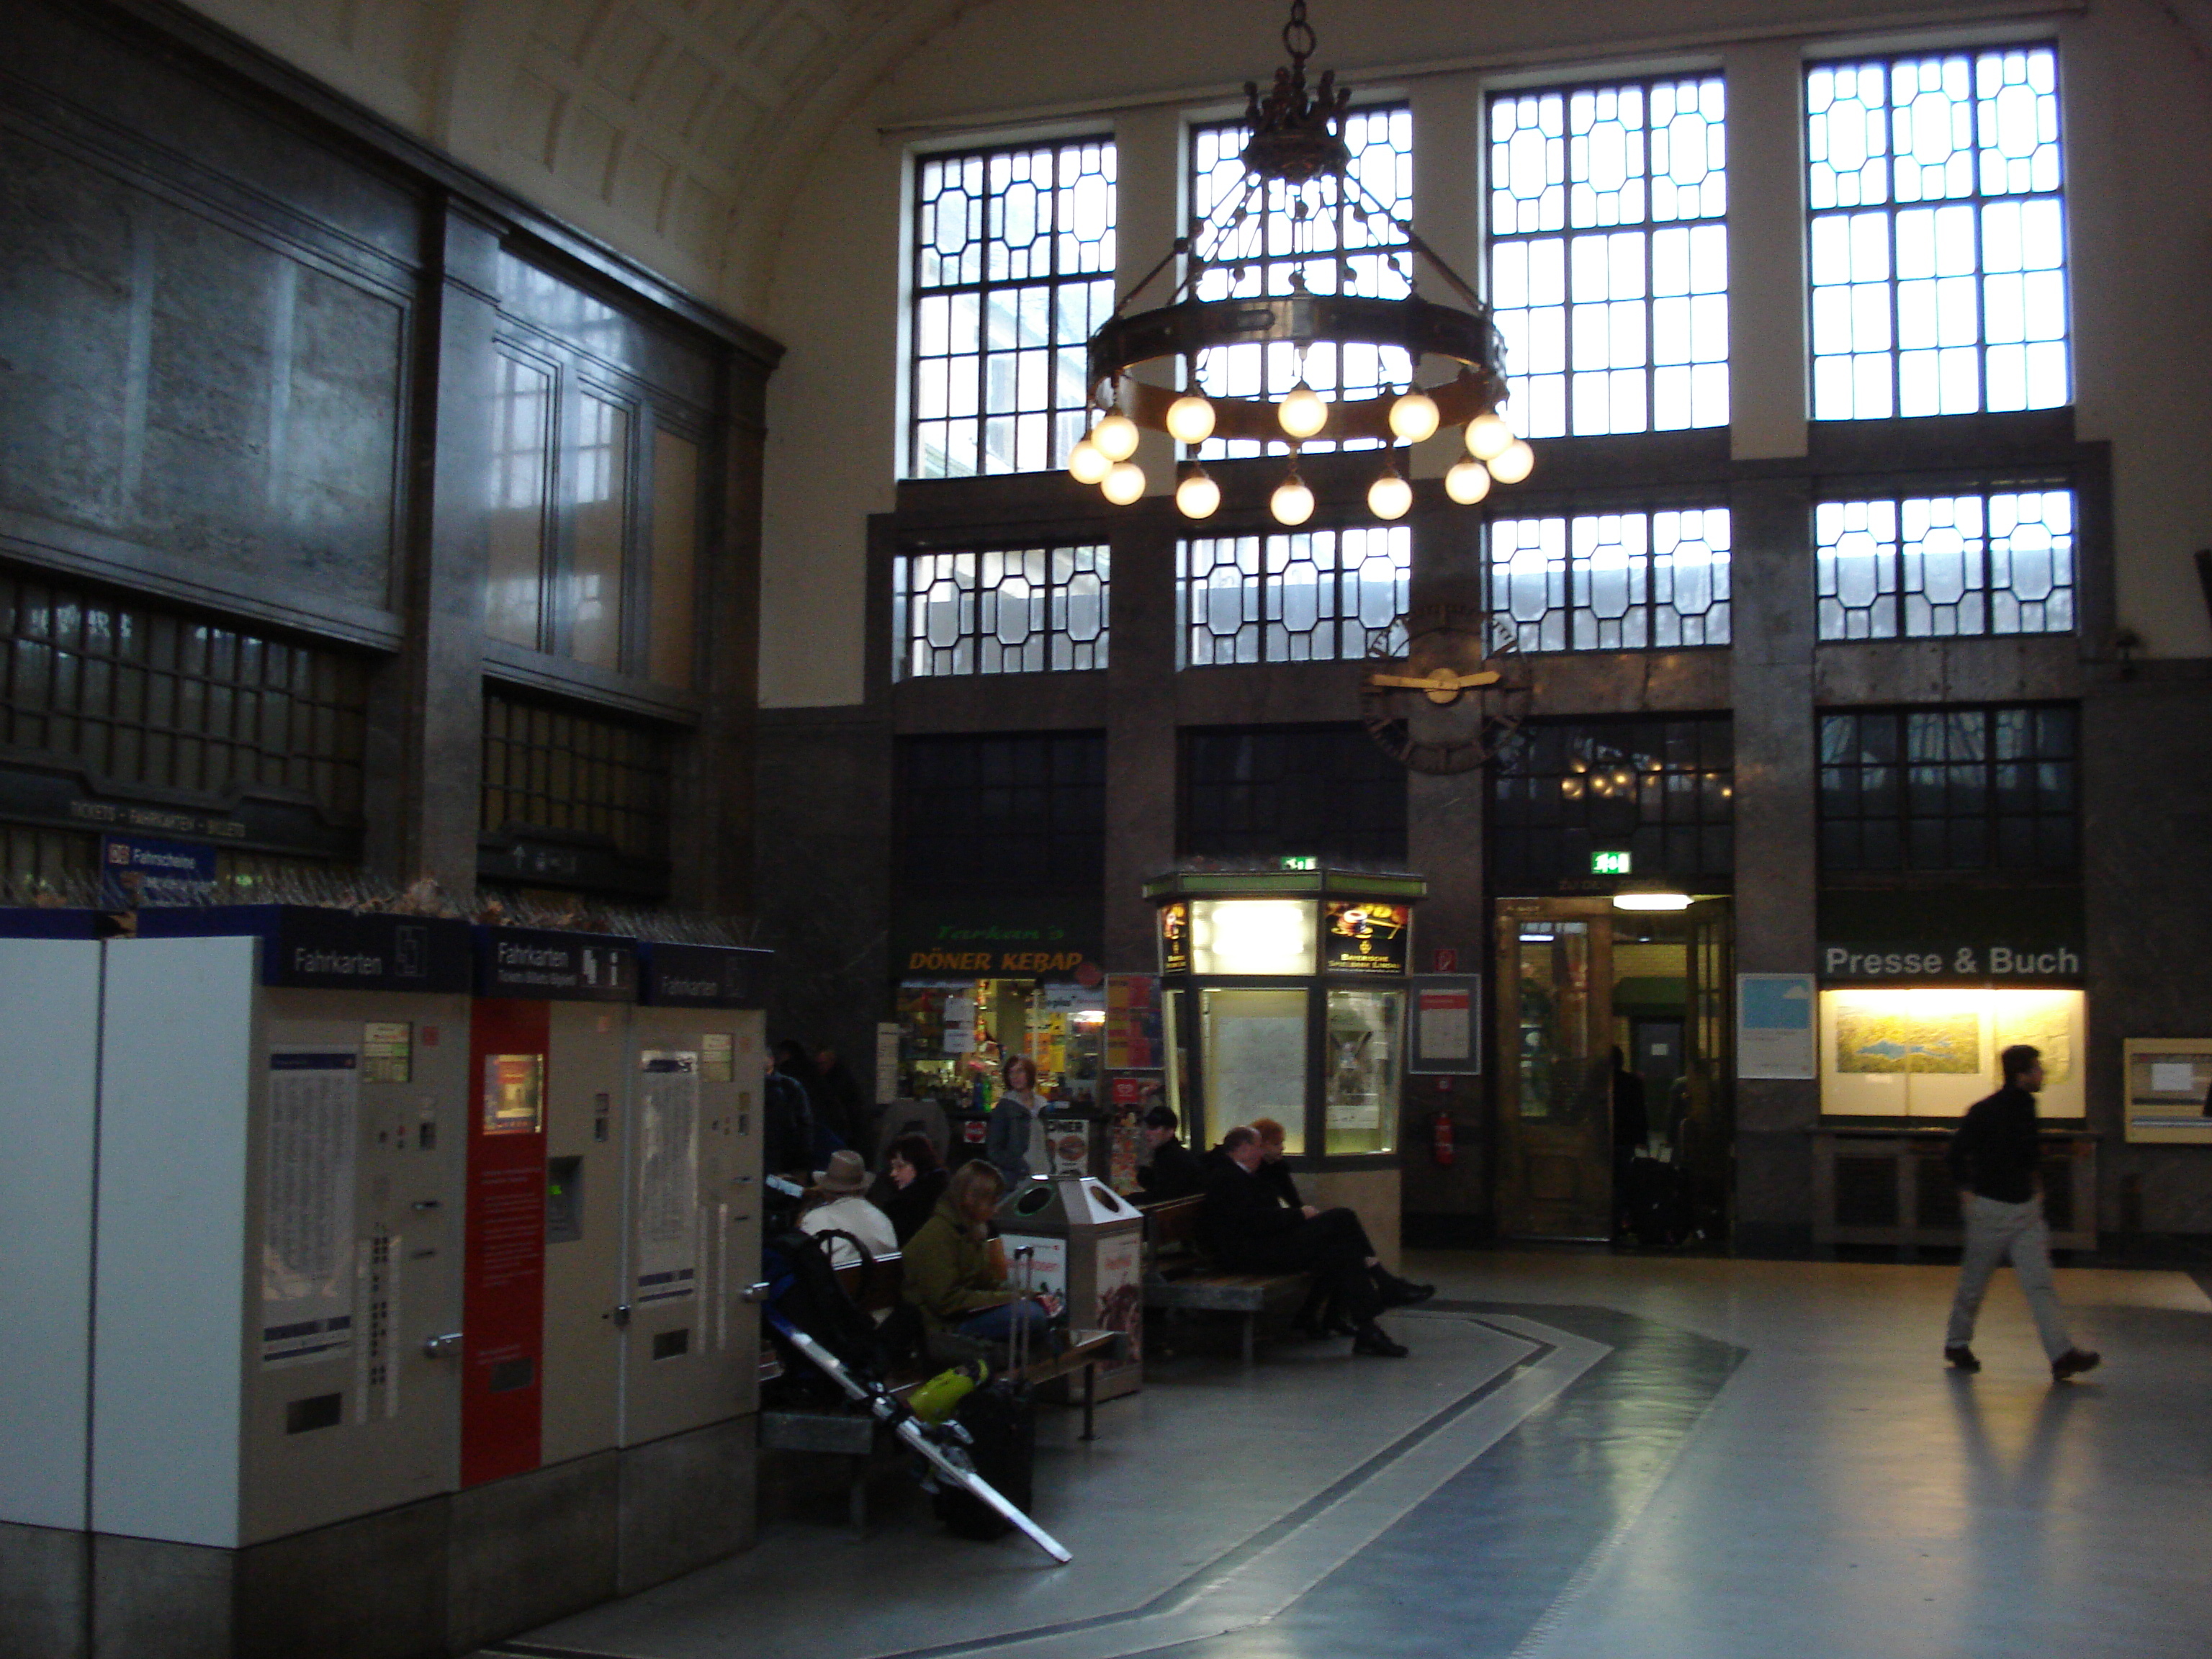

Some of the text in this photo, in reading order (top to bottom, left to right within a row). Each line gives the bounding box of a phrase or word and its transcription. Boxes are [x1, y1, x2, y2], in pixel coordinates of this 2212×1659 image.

[295, 947, 383, 975] Fahrkarten
[908, 947, 1083, 972] DÖNER KEBAP
[1825, 946, 2079, 974] Presse & Buch
